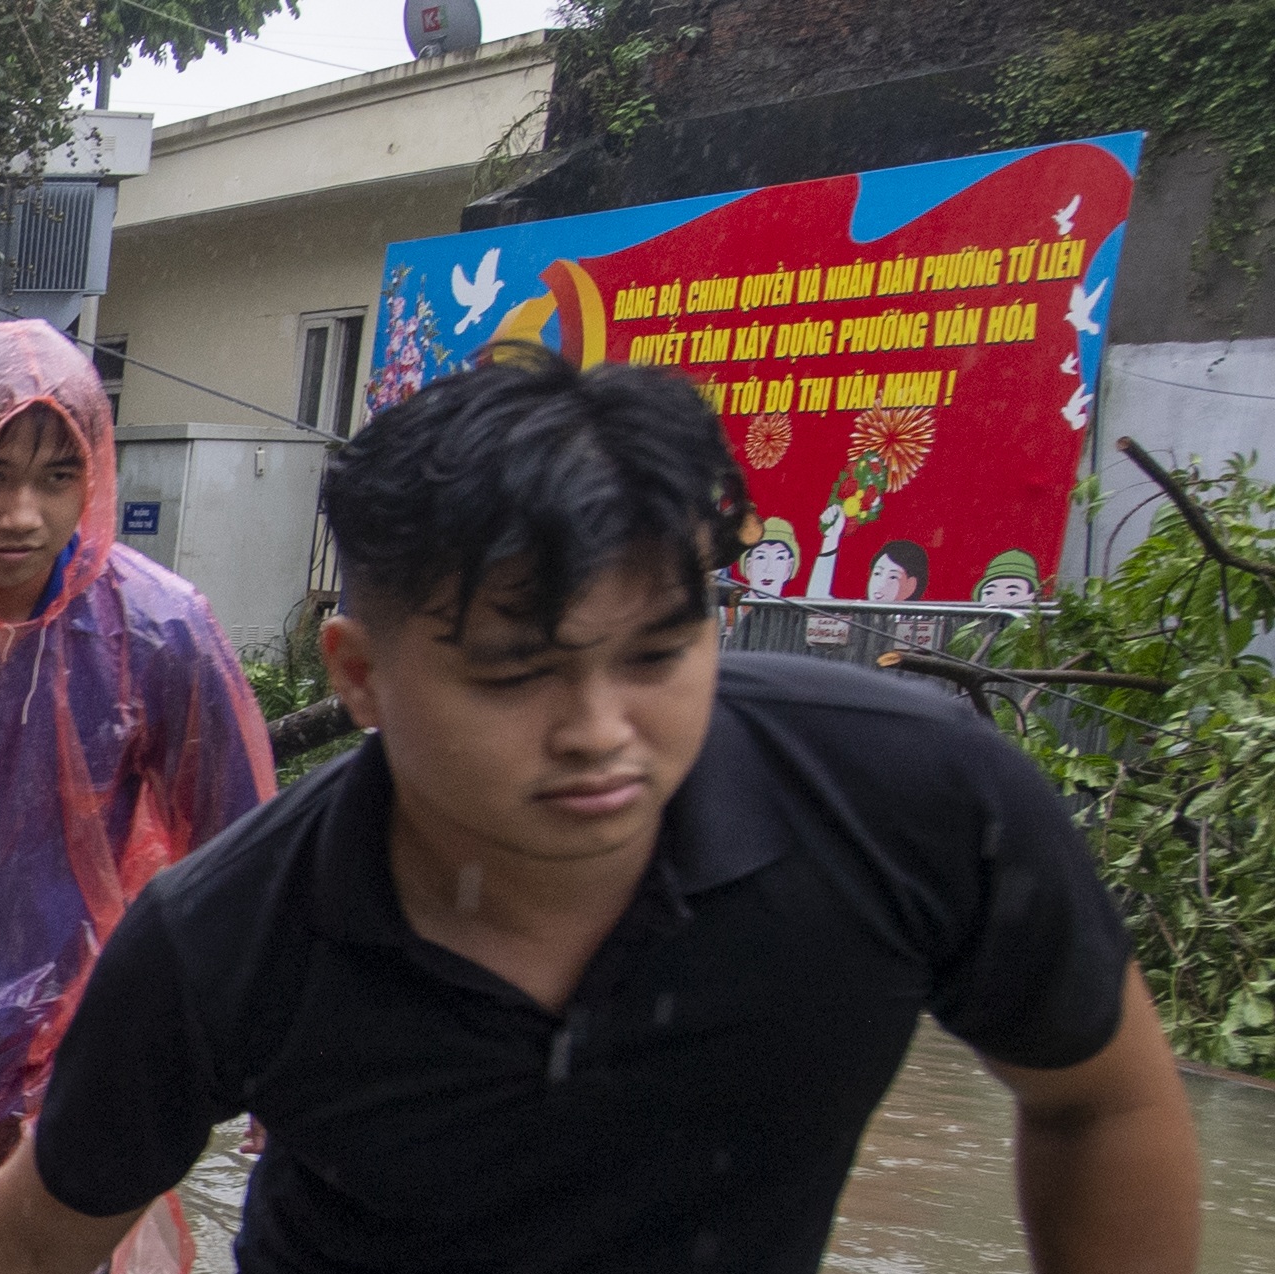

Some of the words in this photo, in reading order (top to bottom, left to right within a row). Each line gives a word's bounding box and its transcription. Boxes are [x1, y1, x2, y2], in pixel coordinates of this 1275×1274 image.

[613, 280, 656, 321] ĐẢNG
[685, 273, 739, 315] CHÍNH
[739, 261, 795, 313] QUYỀN
[797, 263, 822, 305] VÀ
[823, 257, 876, 301] NHÂN
[876, 253, 918, 296] DÂN
[919, 245, 1002, 292] PHƯỜNG
[1006, 238, 1040, 285] TỨ
[1036, 234, 1086, 281] LIÊN
[629, 322, 687, 367] QUYẾT
[689, 324, 732, 365] TÂM
[732, 320, 774, 361] XÂY
[774, 317, 834, 364] DỰNG
[835, 309, 929, 355] PHƯỜNG
[933, 303, 983, 348] VĂN
[984, 298, 1038, 344] HÓA
[730, 375, 763, 416] TỚI
[764, 373, 795, 414] ĐÔ
[797, 376, 834, 418] THỊ
[835, 369, 879, 411] VĂN
[881, 370, 942, 408] MINH
[943, 369, 958, 406] !
